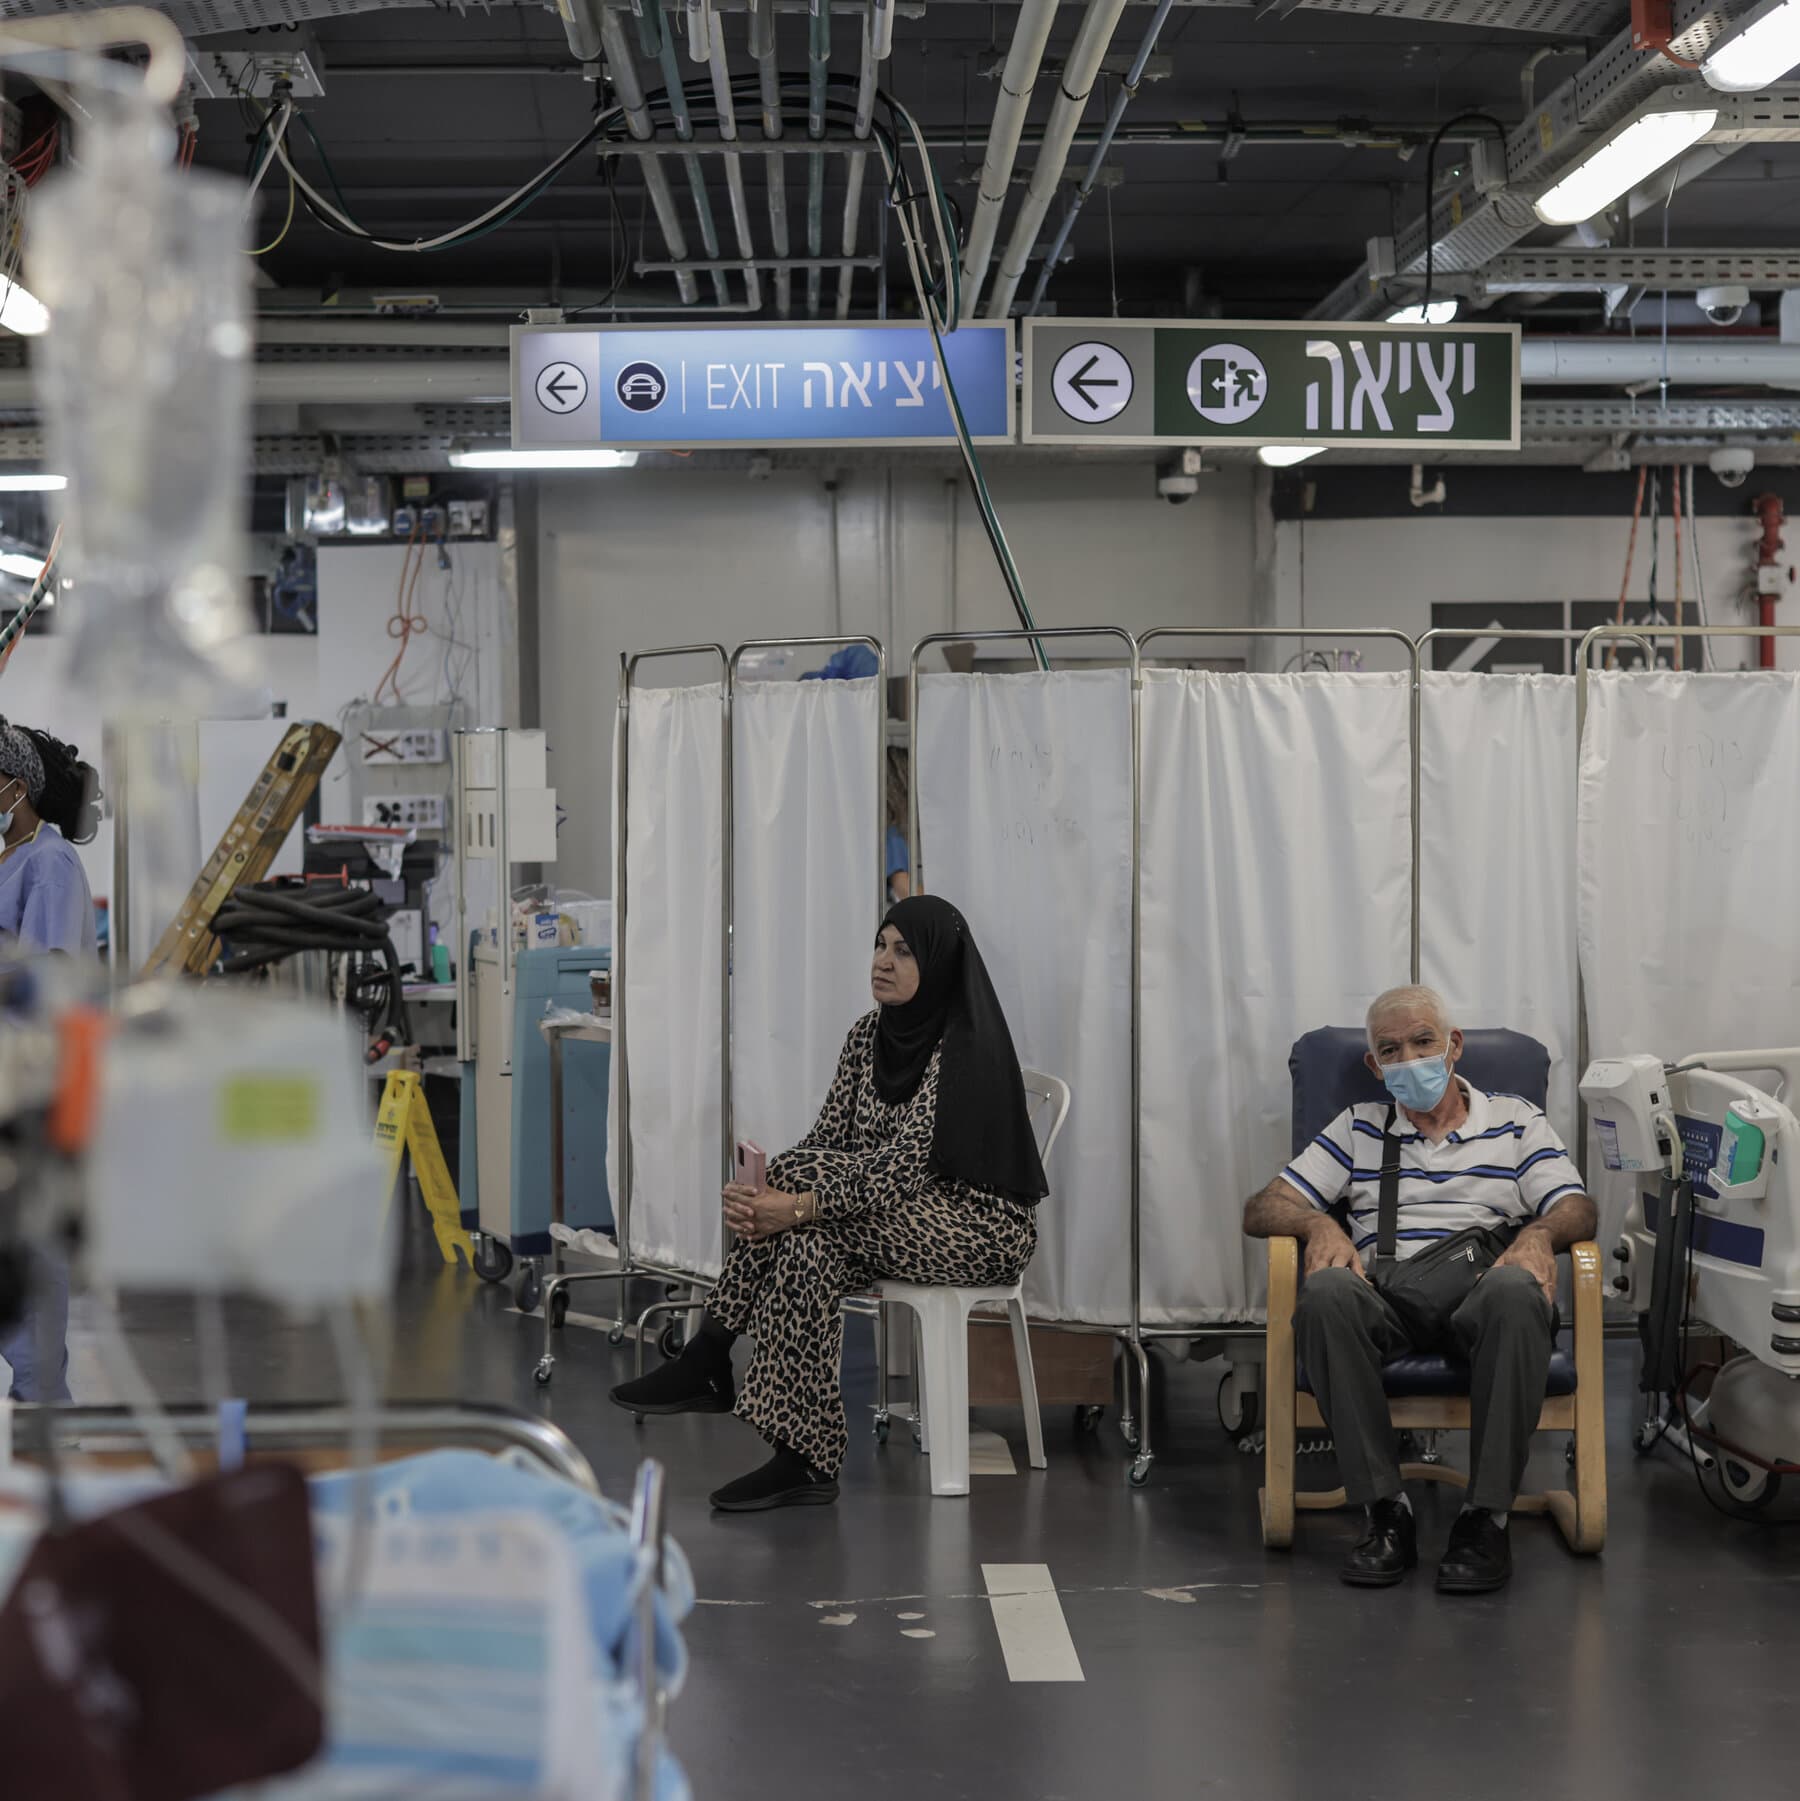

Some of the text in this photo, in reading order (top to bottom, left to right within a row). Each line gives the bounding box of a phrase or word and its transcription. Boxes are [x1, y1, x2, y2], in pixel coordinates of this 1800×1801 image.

[706, 363, 785, 409] EXIT
[803, 361, 940, 408] יציאה
[1306, 340, 1475, 433] יציאה
